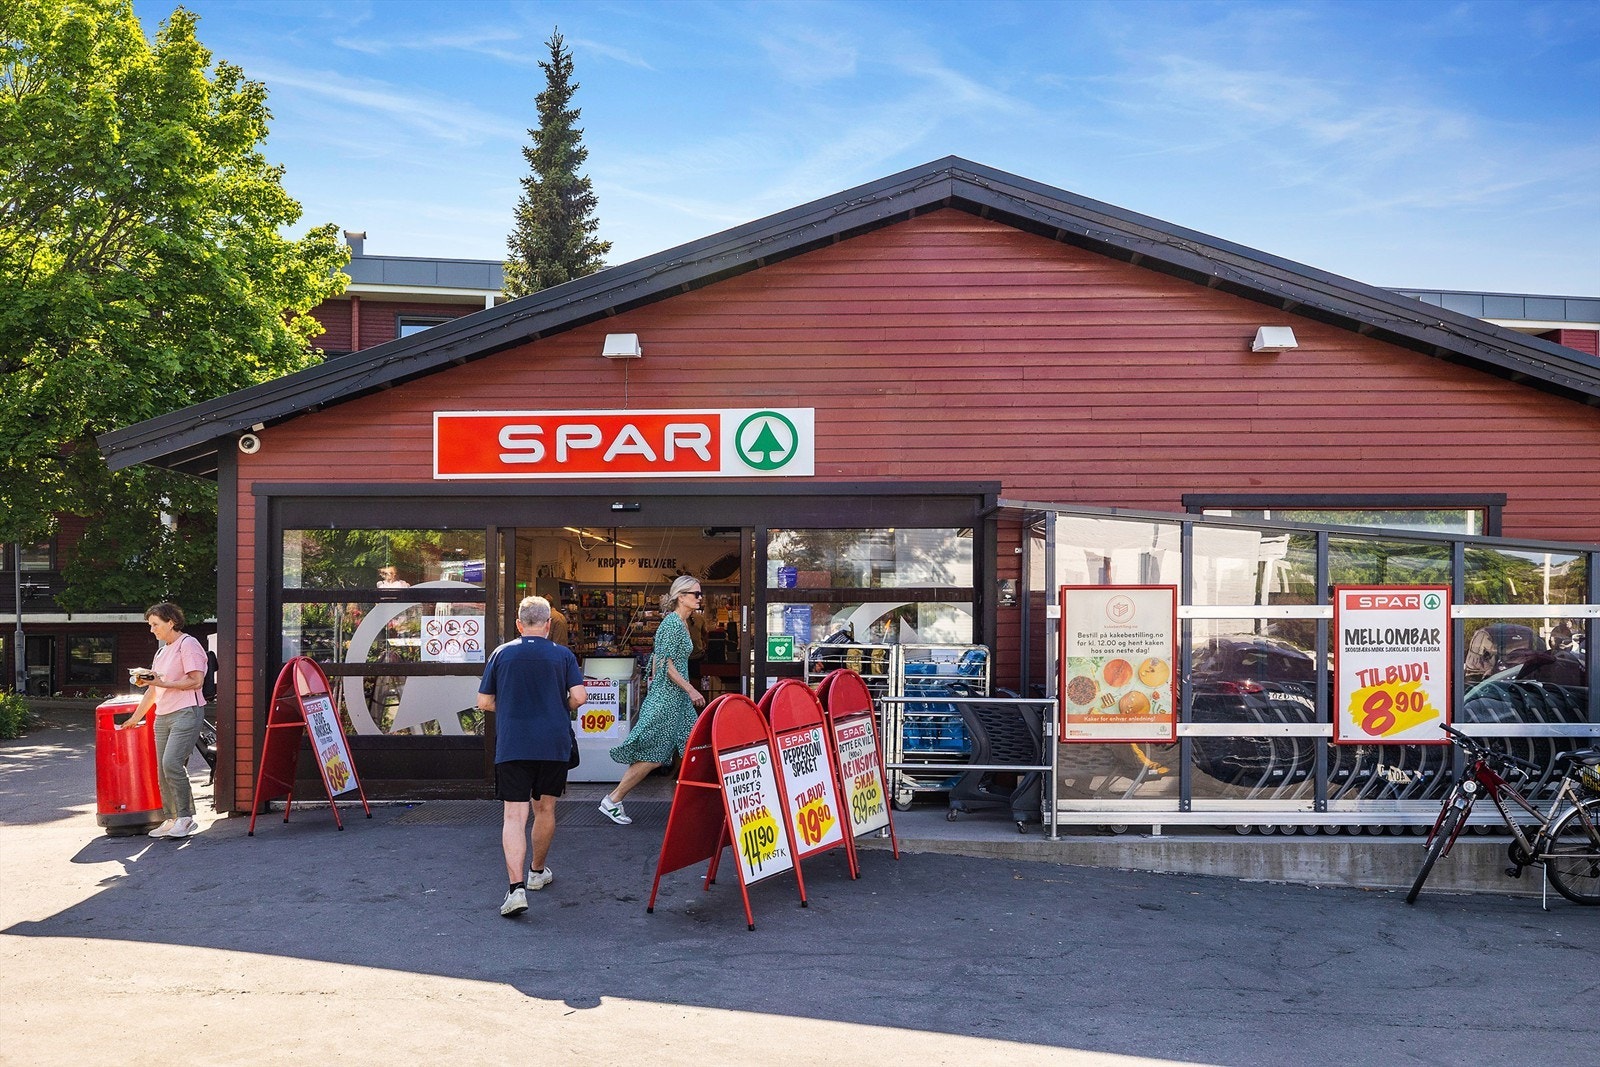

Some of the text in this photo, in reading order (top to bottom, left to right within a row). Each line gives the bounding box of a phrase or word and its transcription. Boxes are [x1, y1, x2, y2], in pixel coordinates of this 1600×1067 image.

[499, 423, 712, 464] SPAR
[598, 558, 625, 568] KROPP
[1359, 596, 1418, 607] SPAR
[1344, 628, 1440, 646] MELLOMBAR
[1355, 662, 1430, 688] TILBUD!
[307, 702, 321, 713] SPAR
[785, 732, 810, 747] SPAR
[843, 726, 865, 739] SPAR
[783, 741, 822, 765] PEPPERONI
[839, 735, 874, 753] DETTE ER VILT
[729, 755, 758, 770] SPAR
[792, 757, 818, 777] SPEKET
[725, 765, 762, 786] TILBUD PÅ
[733, 792, 765, 814] LUNSJ-
[795, 781, 826, 809] TILBUD!
[739, 805, 769, 827] KAKER
